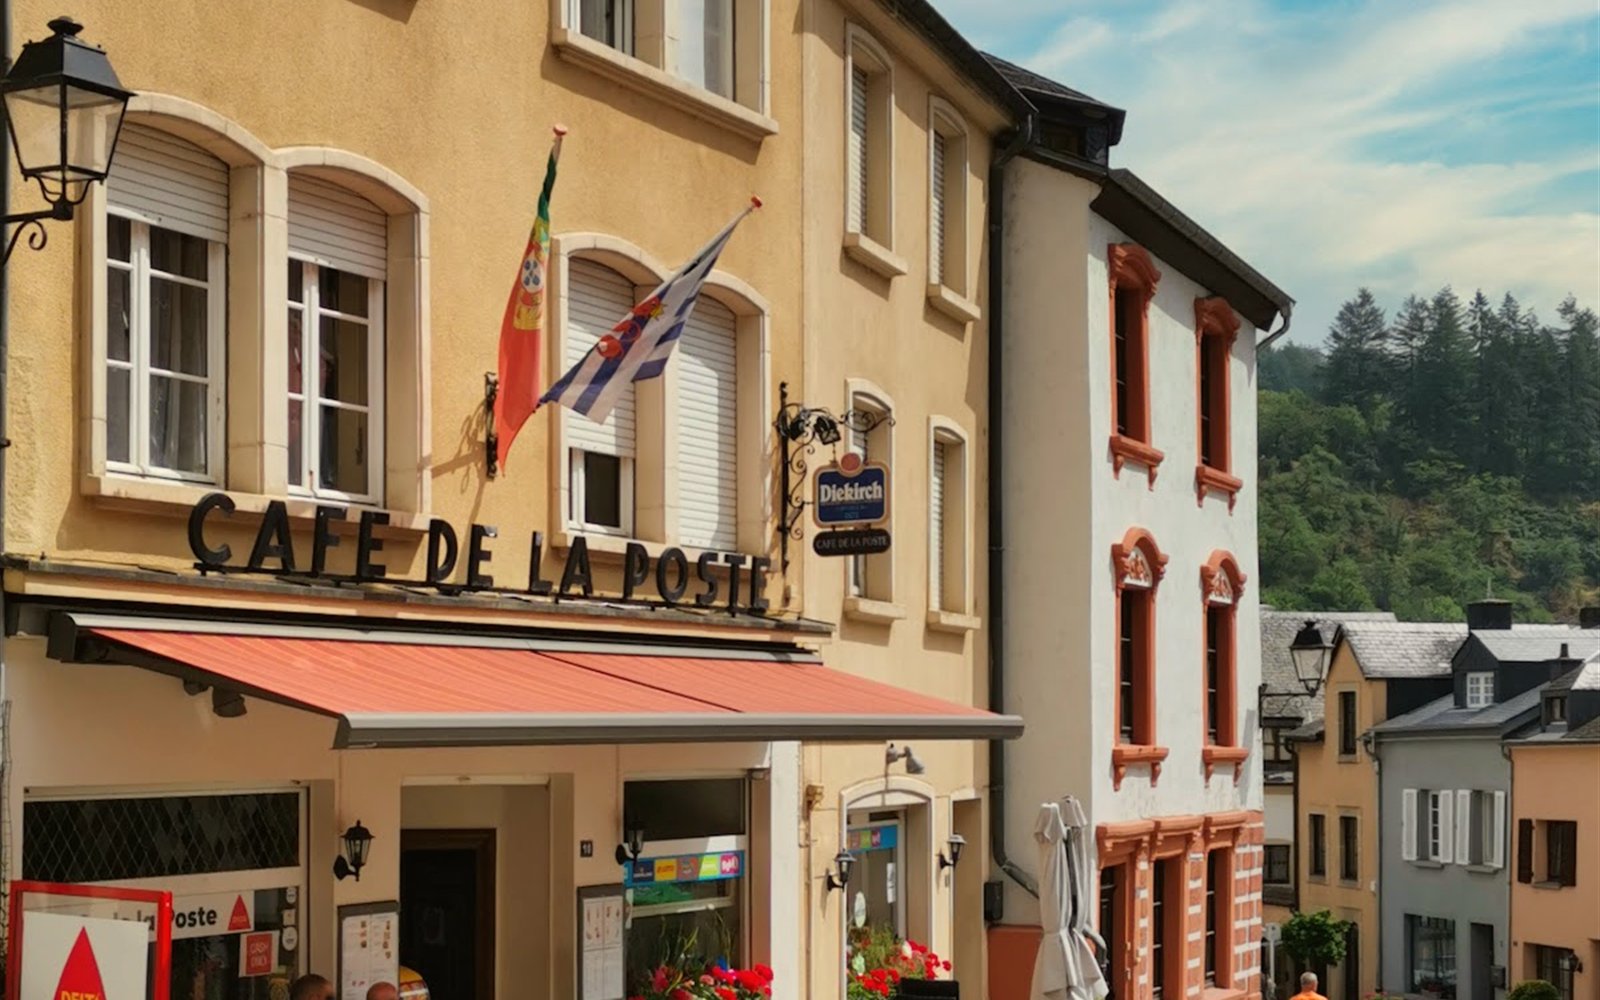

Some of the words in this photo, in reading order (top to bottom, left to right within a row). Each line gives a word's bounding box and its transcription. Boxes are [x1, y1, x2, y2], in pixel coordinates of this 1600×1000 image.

[820, 480, 882, 502] Diekirch
[188, 492, 390, 577] CAFE
[426, 518, 498, 589] DE
[528, 530, 594, 598] LA
[623, 541, 771, 613] POSTE
